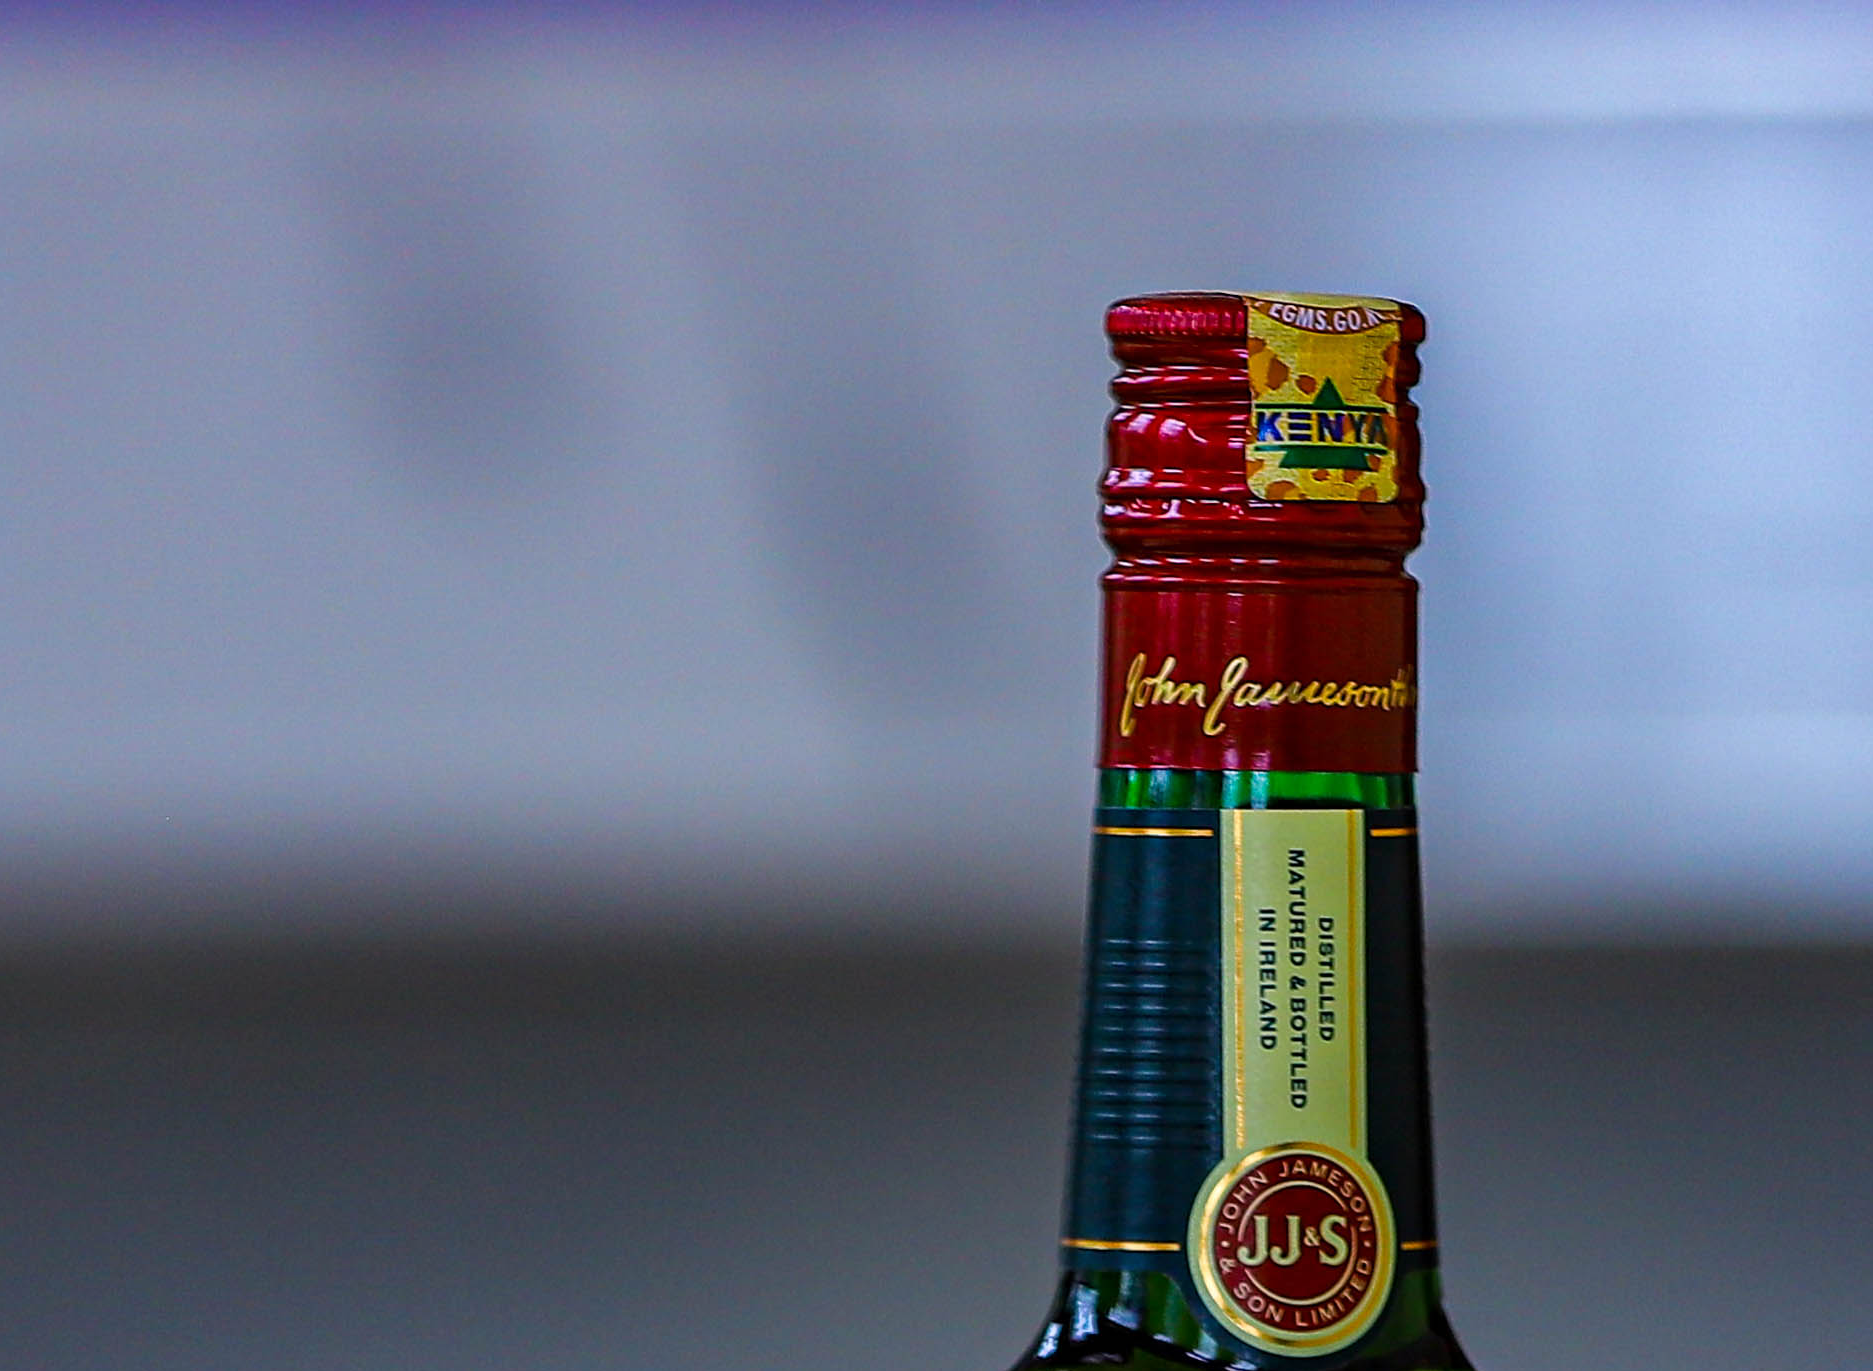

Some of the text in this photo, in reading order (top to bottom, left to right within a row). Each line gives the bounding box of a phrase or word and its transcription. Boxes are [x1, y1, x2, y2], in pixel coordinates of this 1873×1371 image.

[1120, 653, 1206, 737] John
[1259, 908, 1277, 1050] IN IRELAND
[1288, 849, 1307, 1109] MATURED & BOTTLED
[1318, 917, 1335, 1042] DISTILLED
[1219, 1160, 1373, 1234] JOHN JAMESON
[1237, 1214, 1349, 1266] JJ&S
[1233, 1282, 1284, 1322] SON
[1295, 1259, 1371, 1327] LIMITED
